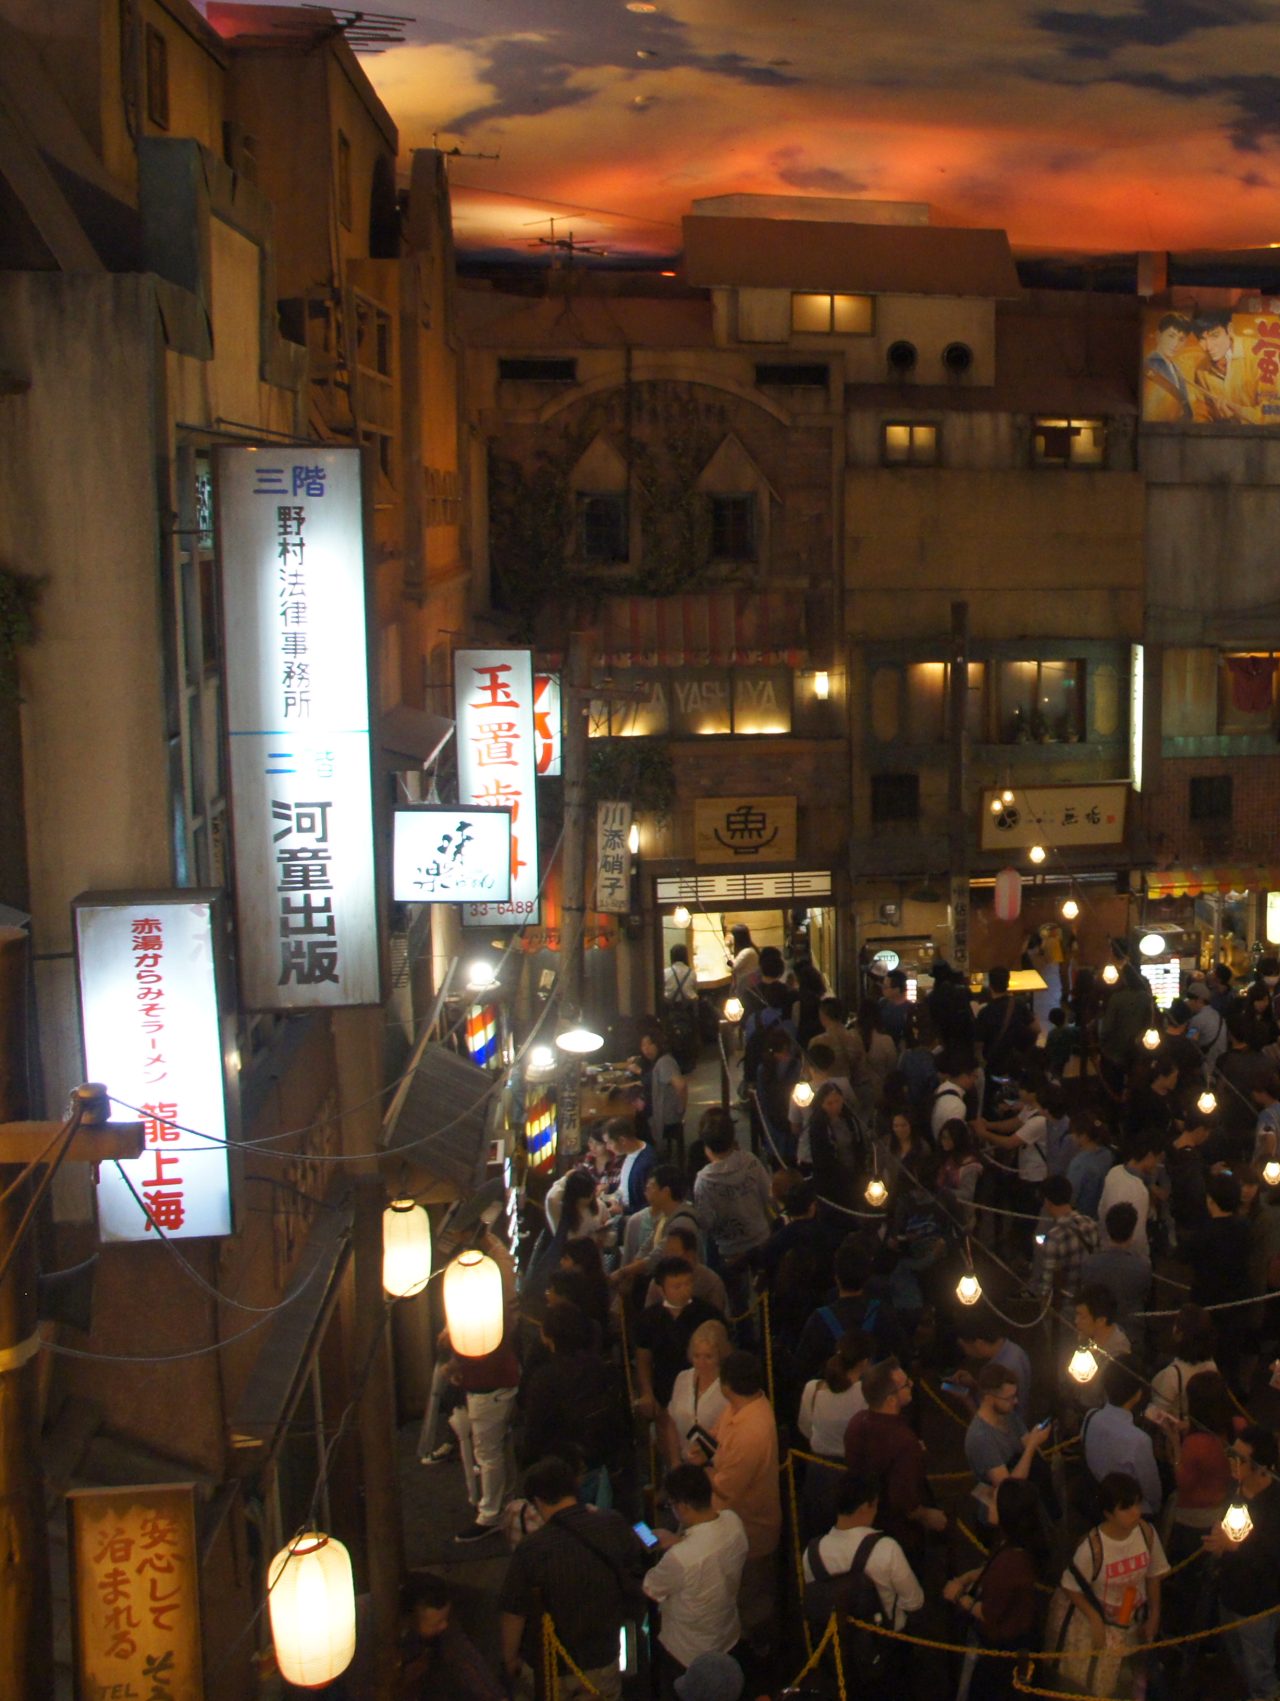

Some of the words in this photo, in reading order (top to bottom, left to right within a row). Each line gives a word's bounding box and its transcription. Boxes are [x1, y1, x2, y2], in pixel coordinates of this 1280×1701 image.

[253, 465, 328, 498] 三階
[275, 505, 312, 718] 野村法律事務所
[271, 800, 340, 987] 河童出版
[469, 900, 535, 917] 33-6488
[600, 805, 625, 897] 川添硝子
[131, 917, 168, 1085] 赤湯からみそラーメン
[138, 1101, 187, 1232] 龍上海
[93, 1527, 142, 1661] 泊まれる
[136, 1509, 185, 1631] 安心して
[99, 1682, 139, 1699] TEL
